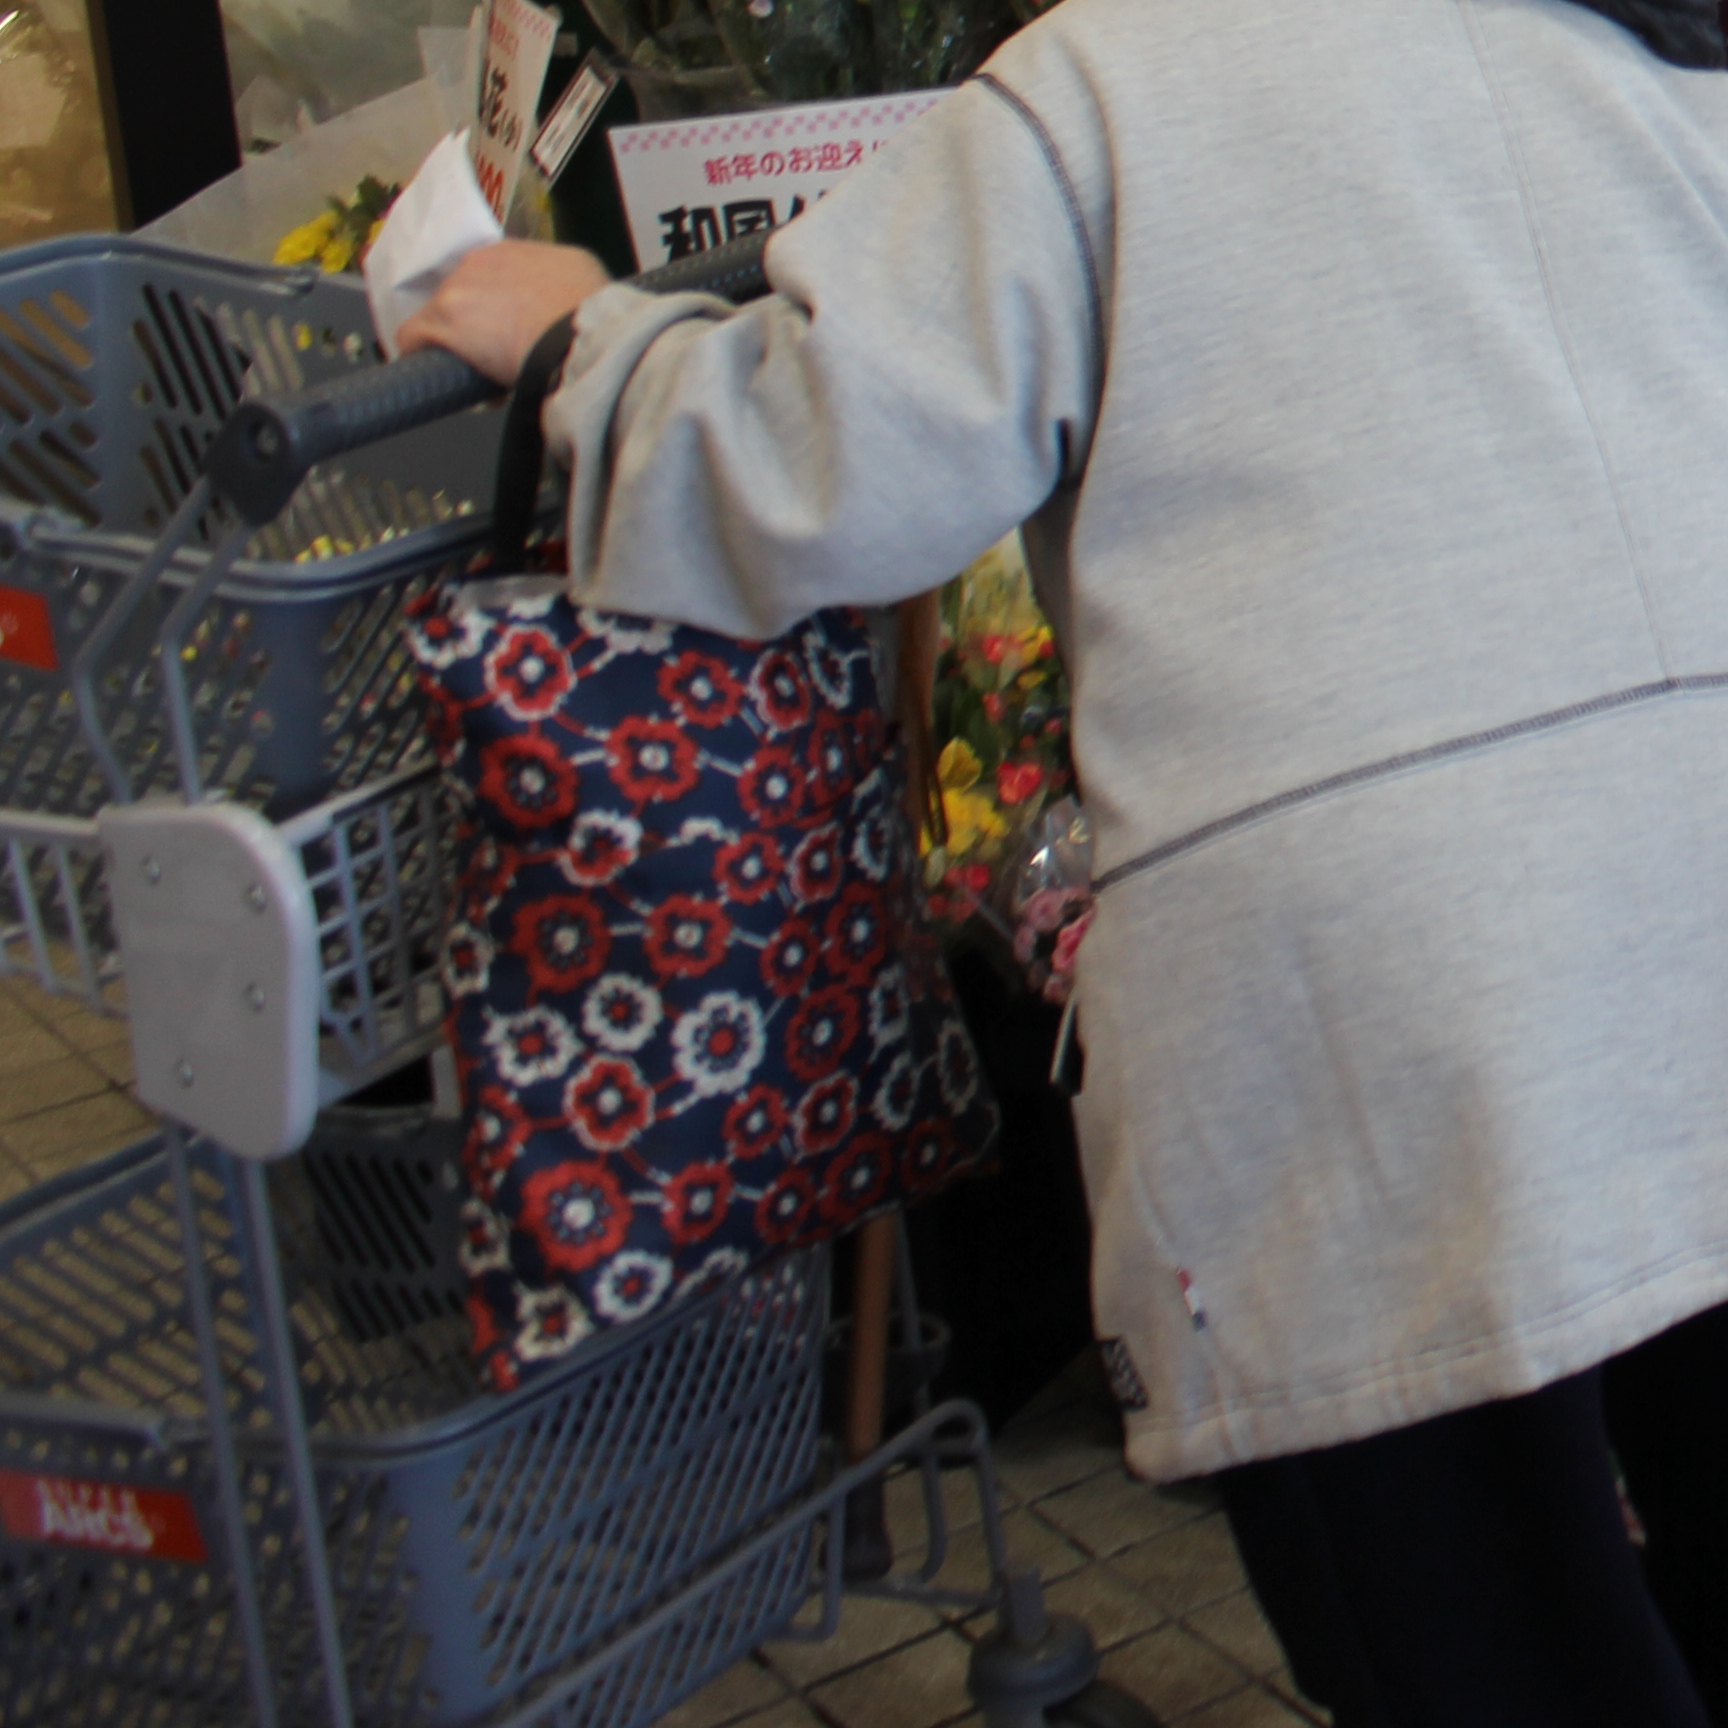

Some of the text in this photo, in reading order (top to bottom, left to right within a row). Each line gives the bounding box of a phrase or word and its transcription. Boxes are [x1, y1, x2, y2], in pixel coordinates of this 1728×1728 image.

[703, 140, 888, 186] 新年のお迎え
